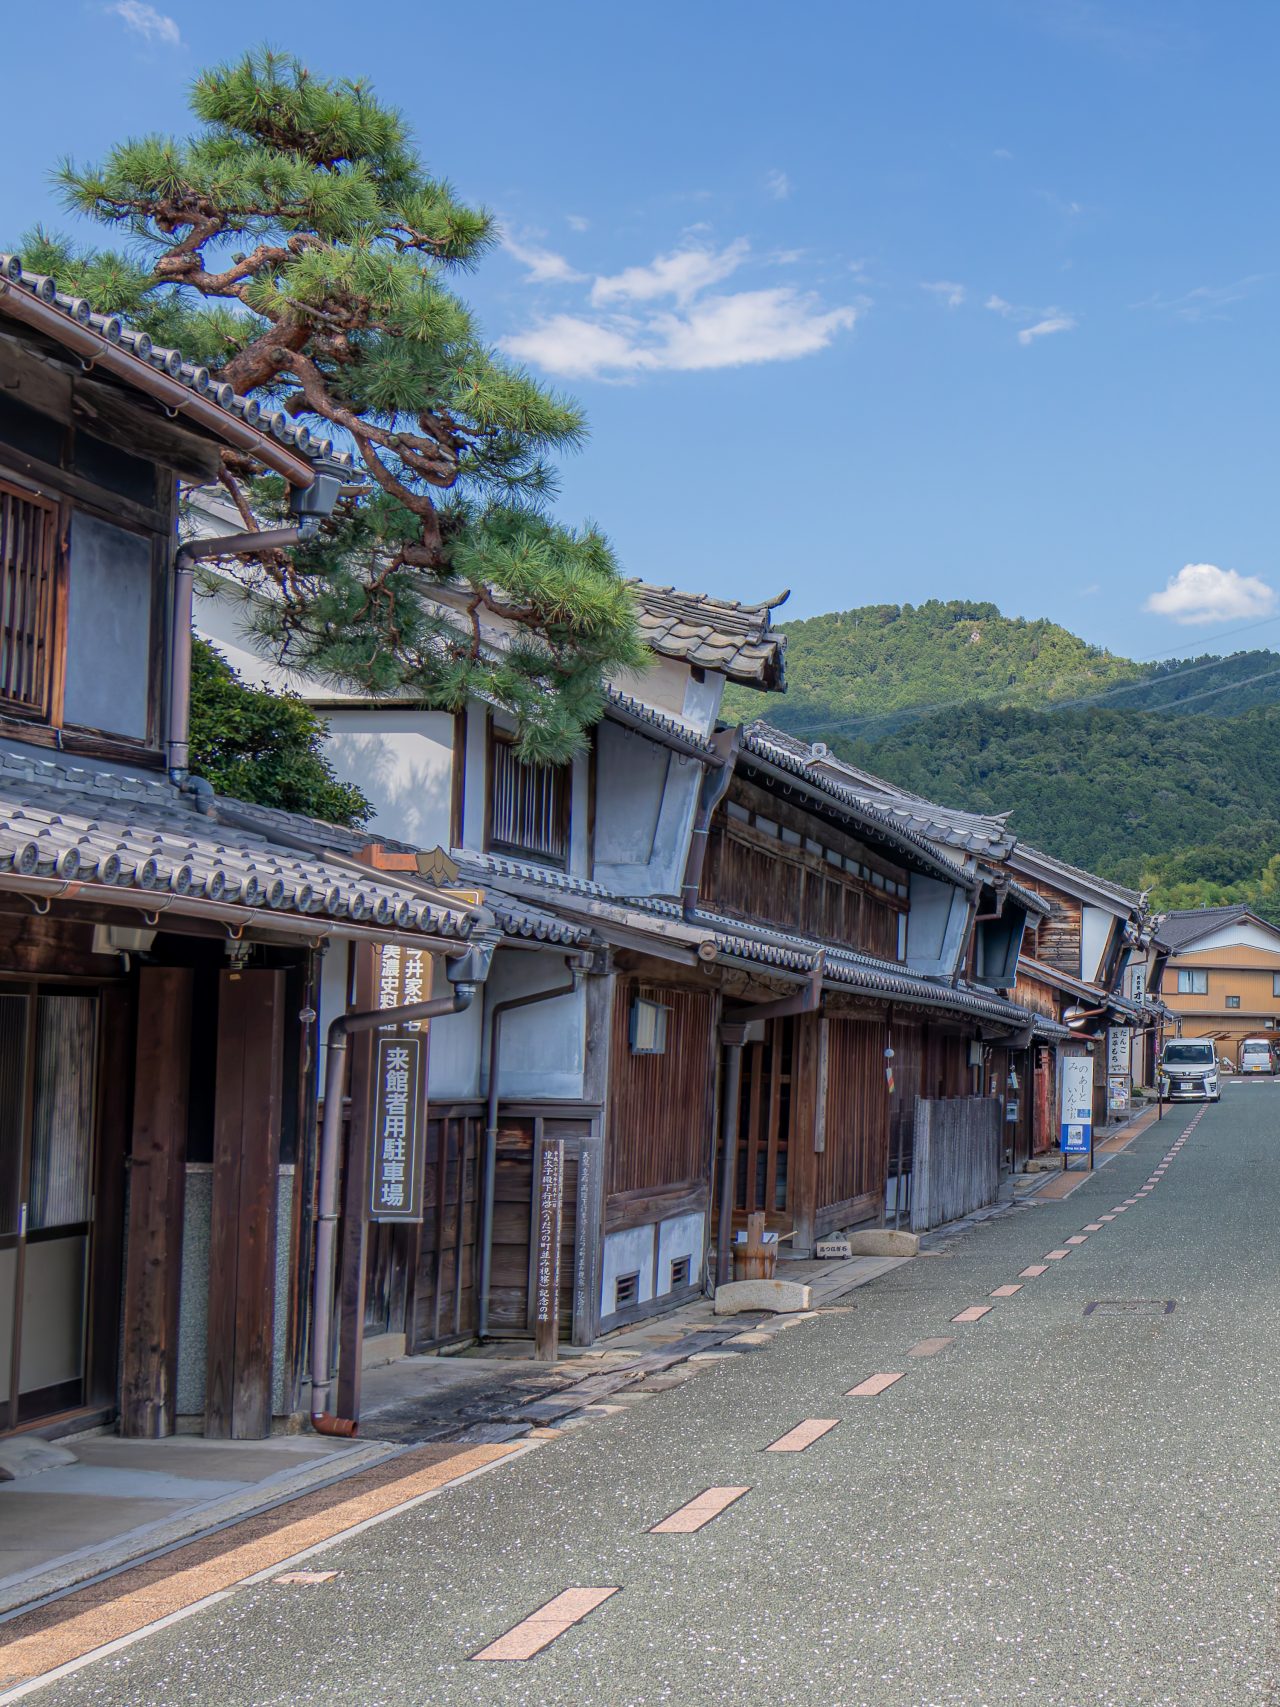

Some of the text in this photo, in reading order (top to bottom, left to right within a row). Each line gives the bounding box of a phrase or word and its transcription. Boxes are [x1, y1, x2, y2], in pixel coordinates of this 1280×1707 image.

[380, 1047, 410, 1207] 来館者用駐車場
